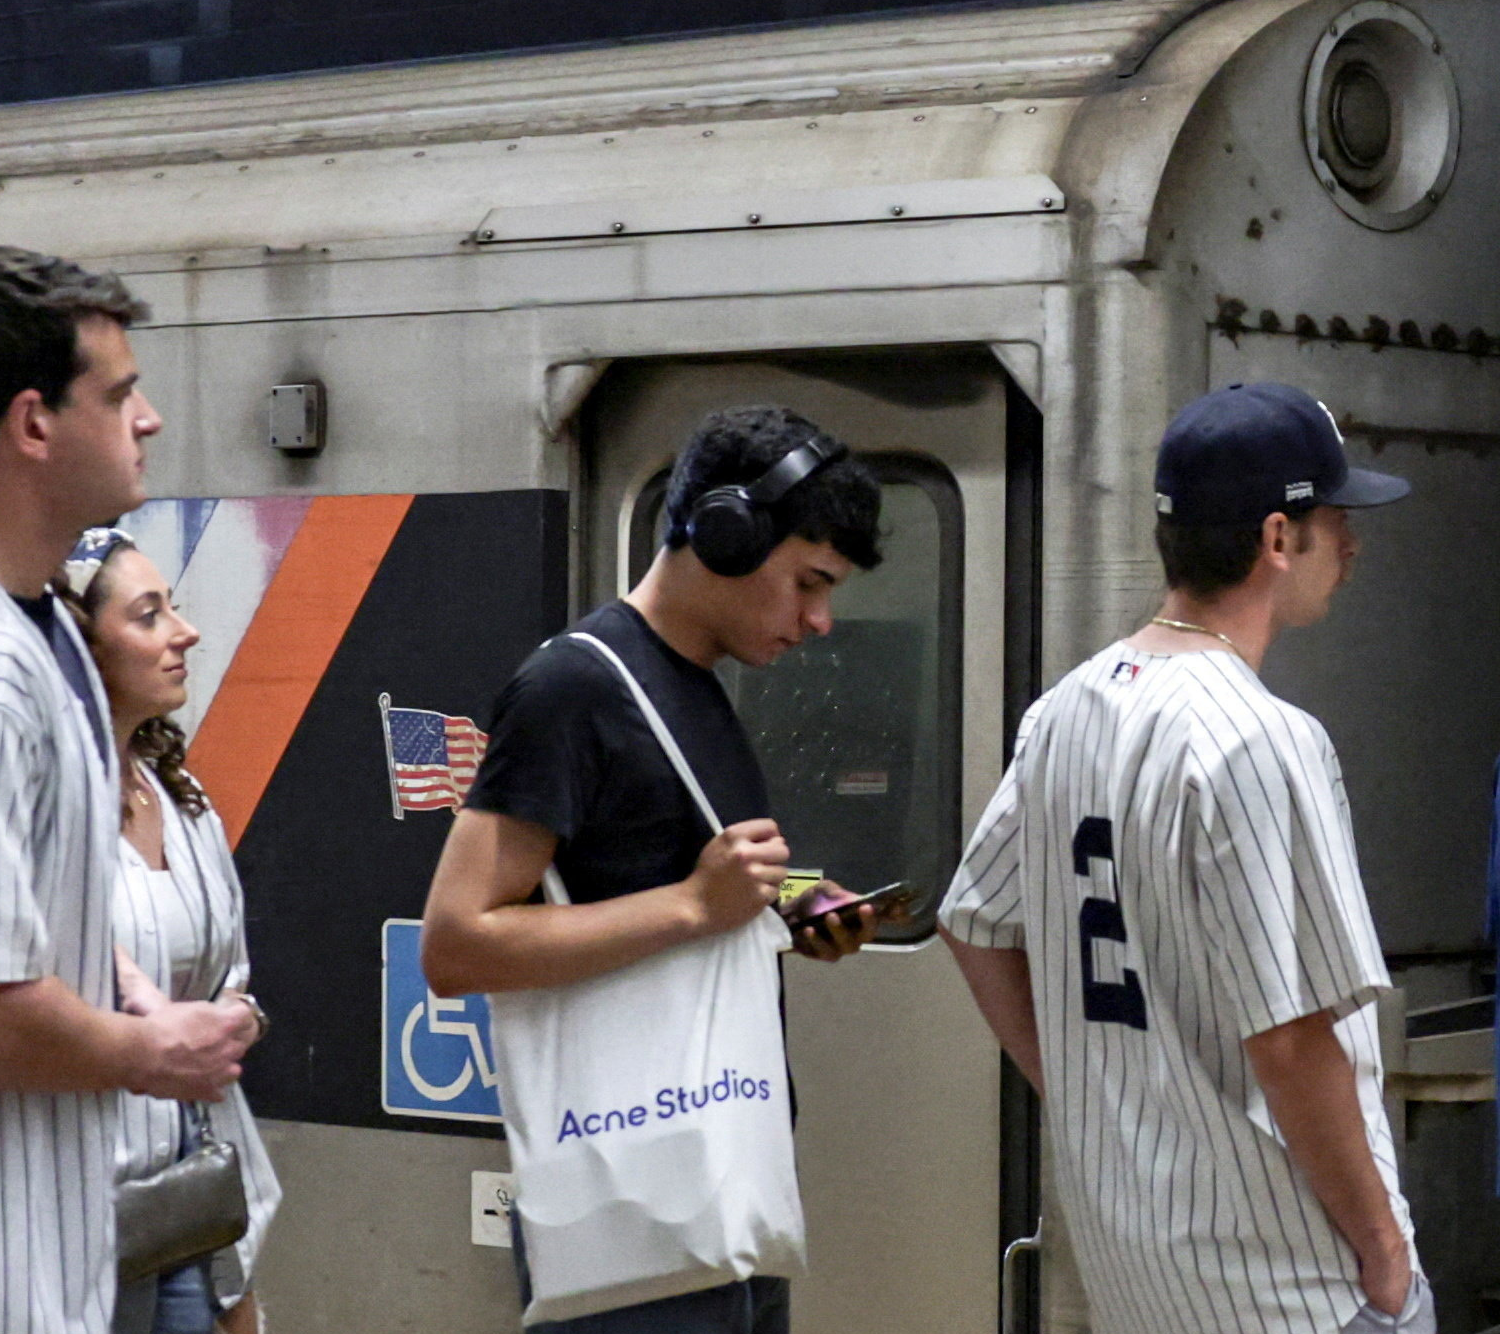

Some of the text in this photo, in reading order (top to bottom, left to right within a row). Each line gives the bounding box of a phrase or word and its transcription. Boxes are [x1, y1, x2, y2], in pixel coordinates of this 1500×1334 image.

[1073, 816, 1148, 1030] 2
[557, 1069, 770, 1144] Acne Studios
